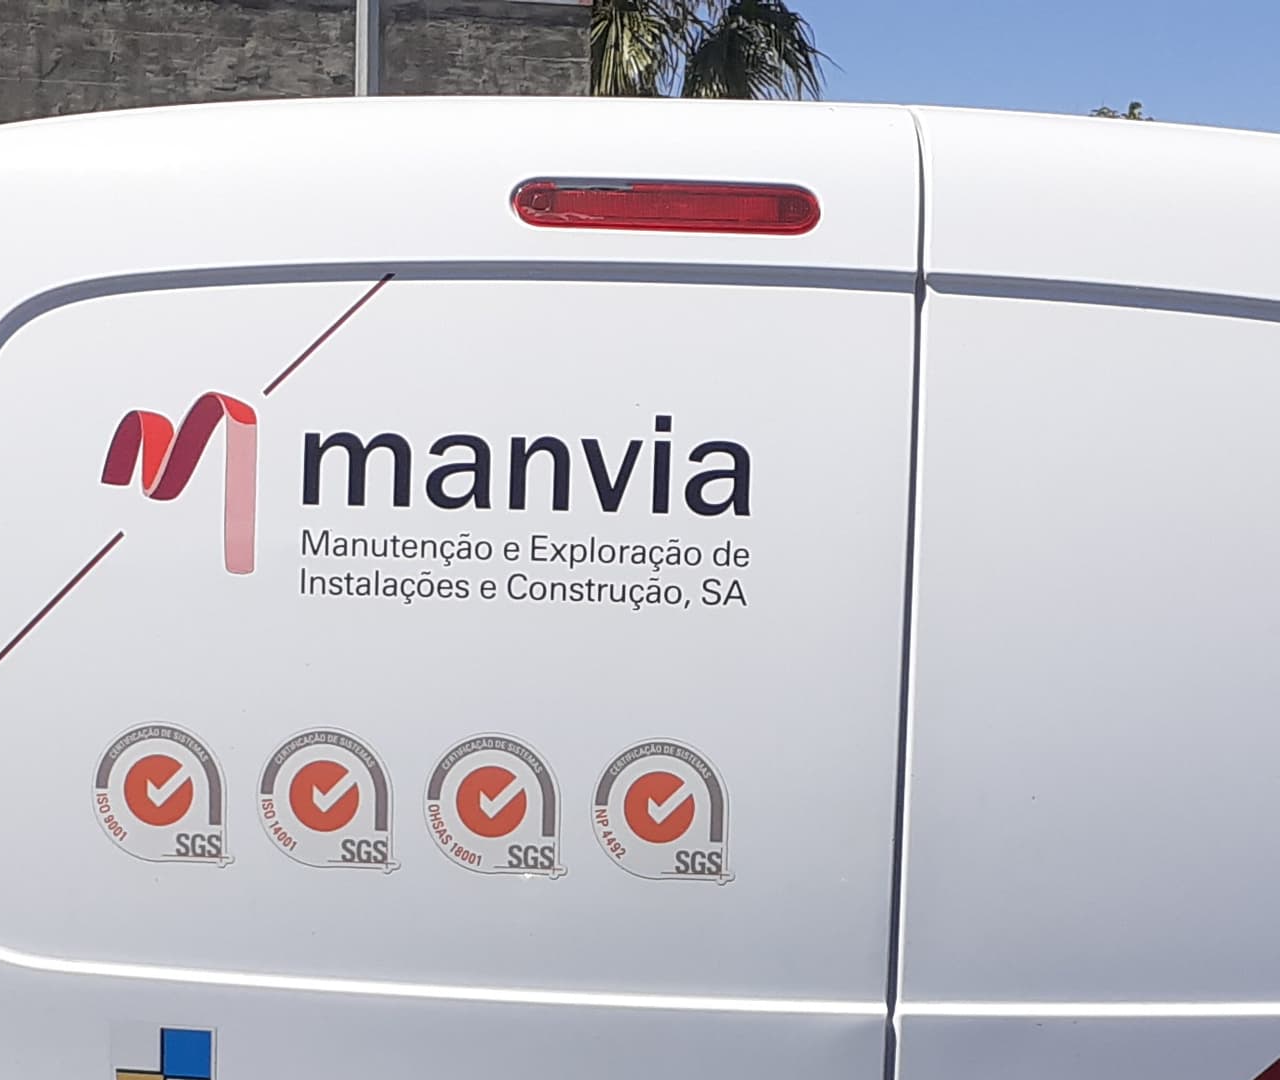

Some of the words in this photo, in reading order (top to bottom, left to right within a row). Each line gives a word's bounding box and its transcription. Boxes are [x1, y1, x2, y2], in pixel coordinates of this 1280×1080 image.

[302, 415, 752, 517] manvia
[301, 529, 492, 567] Manutenção
[503, 541, 520, 562] e
[530, 534, 702, 571] Exploração
[712, 540, 750, 567] de
[300, 567, 470, 604] Instalações
[479, 579, 497, 600] e
[507, 573, 691, 610] Construção,
[701, 578, 748, 606] SA
[663, 745, 675, 755] DE
[96, 793, 111, 814] ISO
[104, 815, 128, 842] 9001
[261, 799, 276, 819] ISO
[269, 820, 297, 851] 14001
[428, 804, 452, 845] OHSAS
[449, 842, 482, 866] 18001
[595, 809, 609, 827] NP
[602, 830, 626, 859] 4492
[176, 833, 222, 857] SGS
[341, 839, 387, 864] SGS
[508, 845, 554, 869] SGS
[675, 850, 721, 875] SGS
